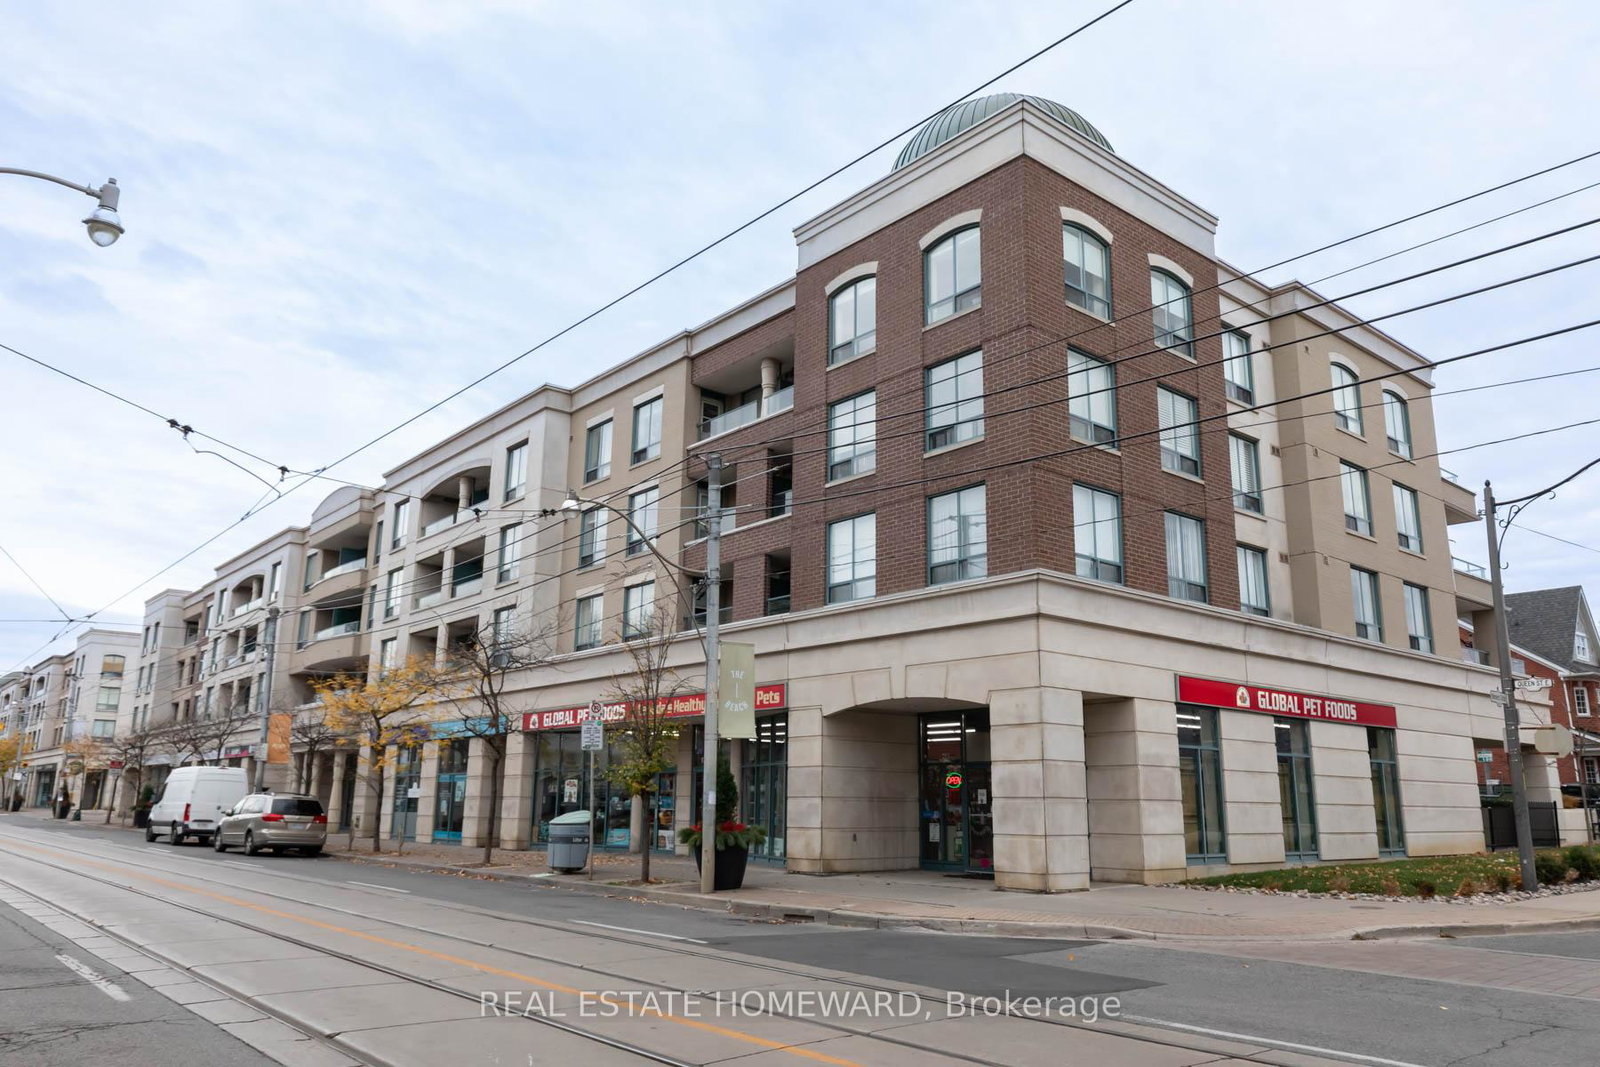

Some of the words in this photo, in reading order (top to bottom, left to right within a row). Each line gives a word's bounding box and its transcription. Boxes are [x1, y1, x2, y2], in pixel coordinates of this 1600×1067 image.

[730, 670, 745, 680] THE
[674, 697, 705, 714] Healthy
[756, 690, 780, 705] Pets
[1257, 691, 1301, 714] GLOBAL
[1303, 697, 1322, 717] PET
[1325, 700, 1357, 720] FOODS
[543, 710, 575, 727] GLOBAL
[595, 704, 626, 721] OODS
